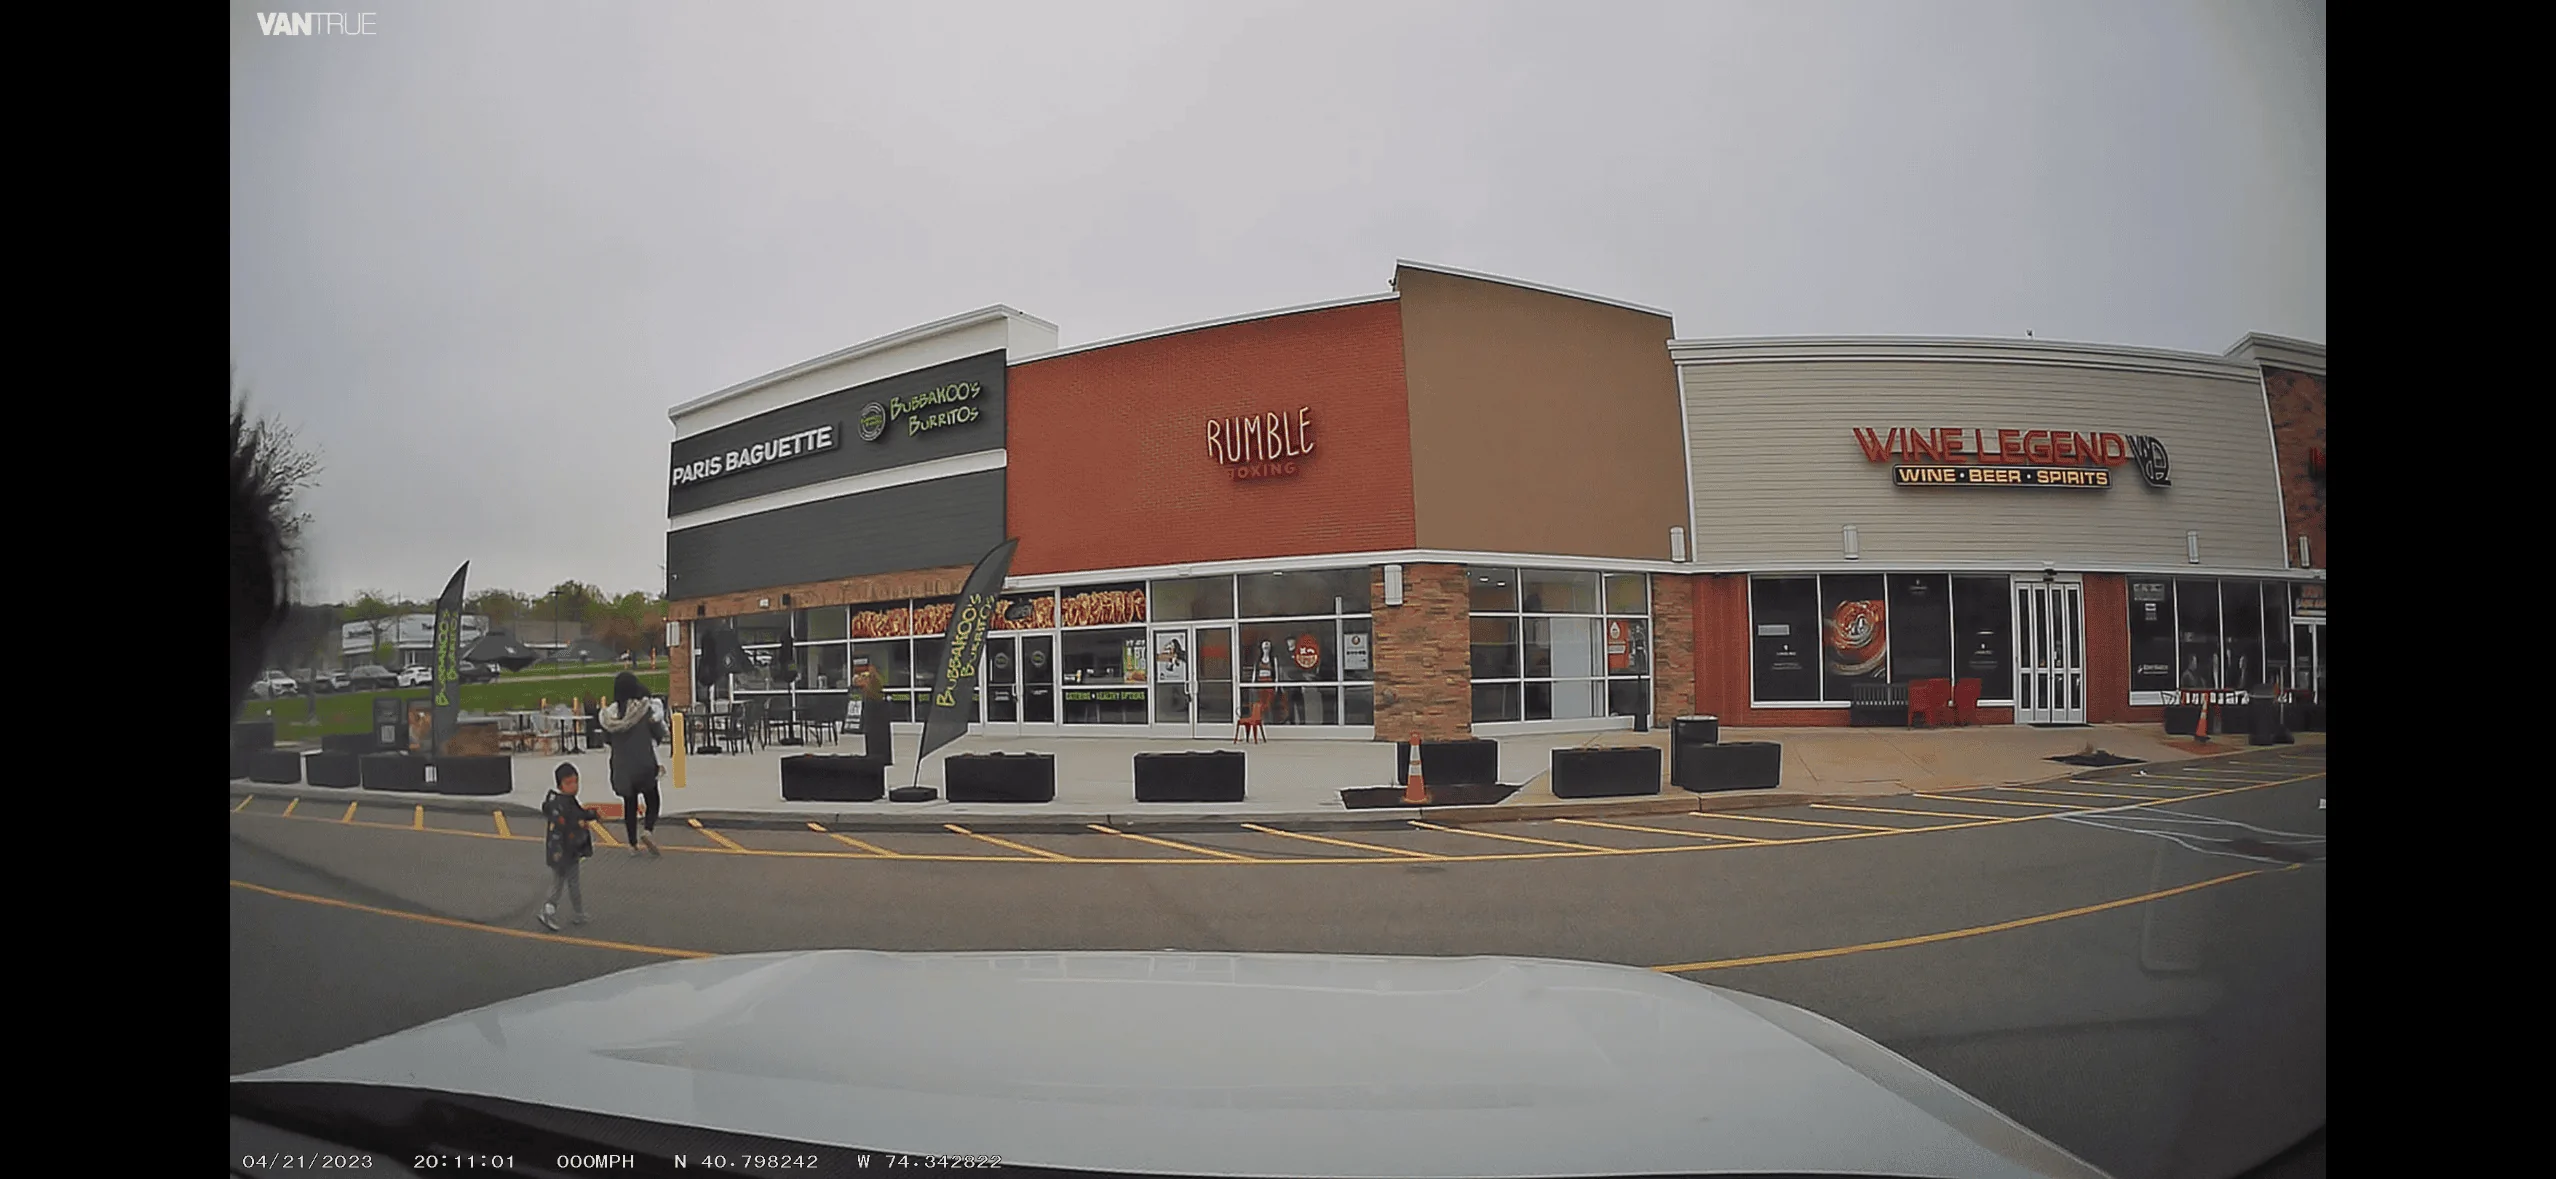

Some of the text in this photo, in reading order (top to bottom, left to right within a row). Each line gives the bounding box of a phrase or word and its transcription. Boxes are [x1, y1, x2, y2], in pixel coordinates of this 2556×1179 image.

[909, 406, 979, 437] BURRITOS
[1207, 406, 1314, 465] RUMBLE
[672, 425, 833, 486] PARIS BAGUETTE
[1853, 427, 1967, 463] WINE
[1975, 428, 2128, 467] LEGEND
[1899, 468, 2108, 486] WINE BEER SPIRITS
